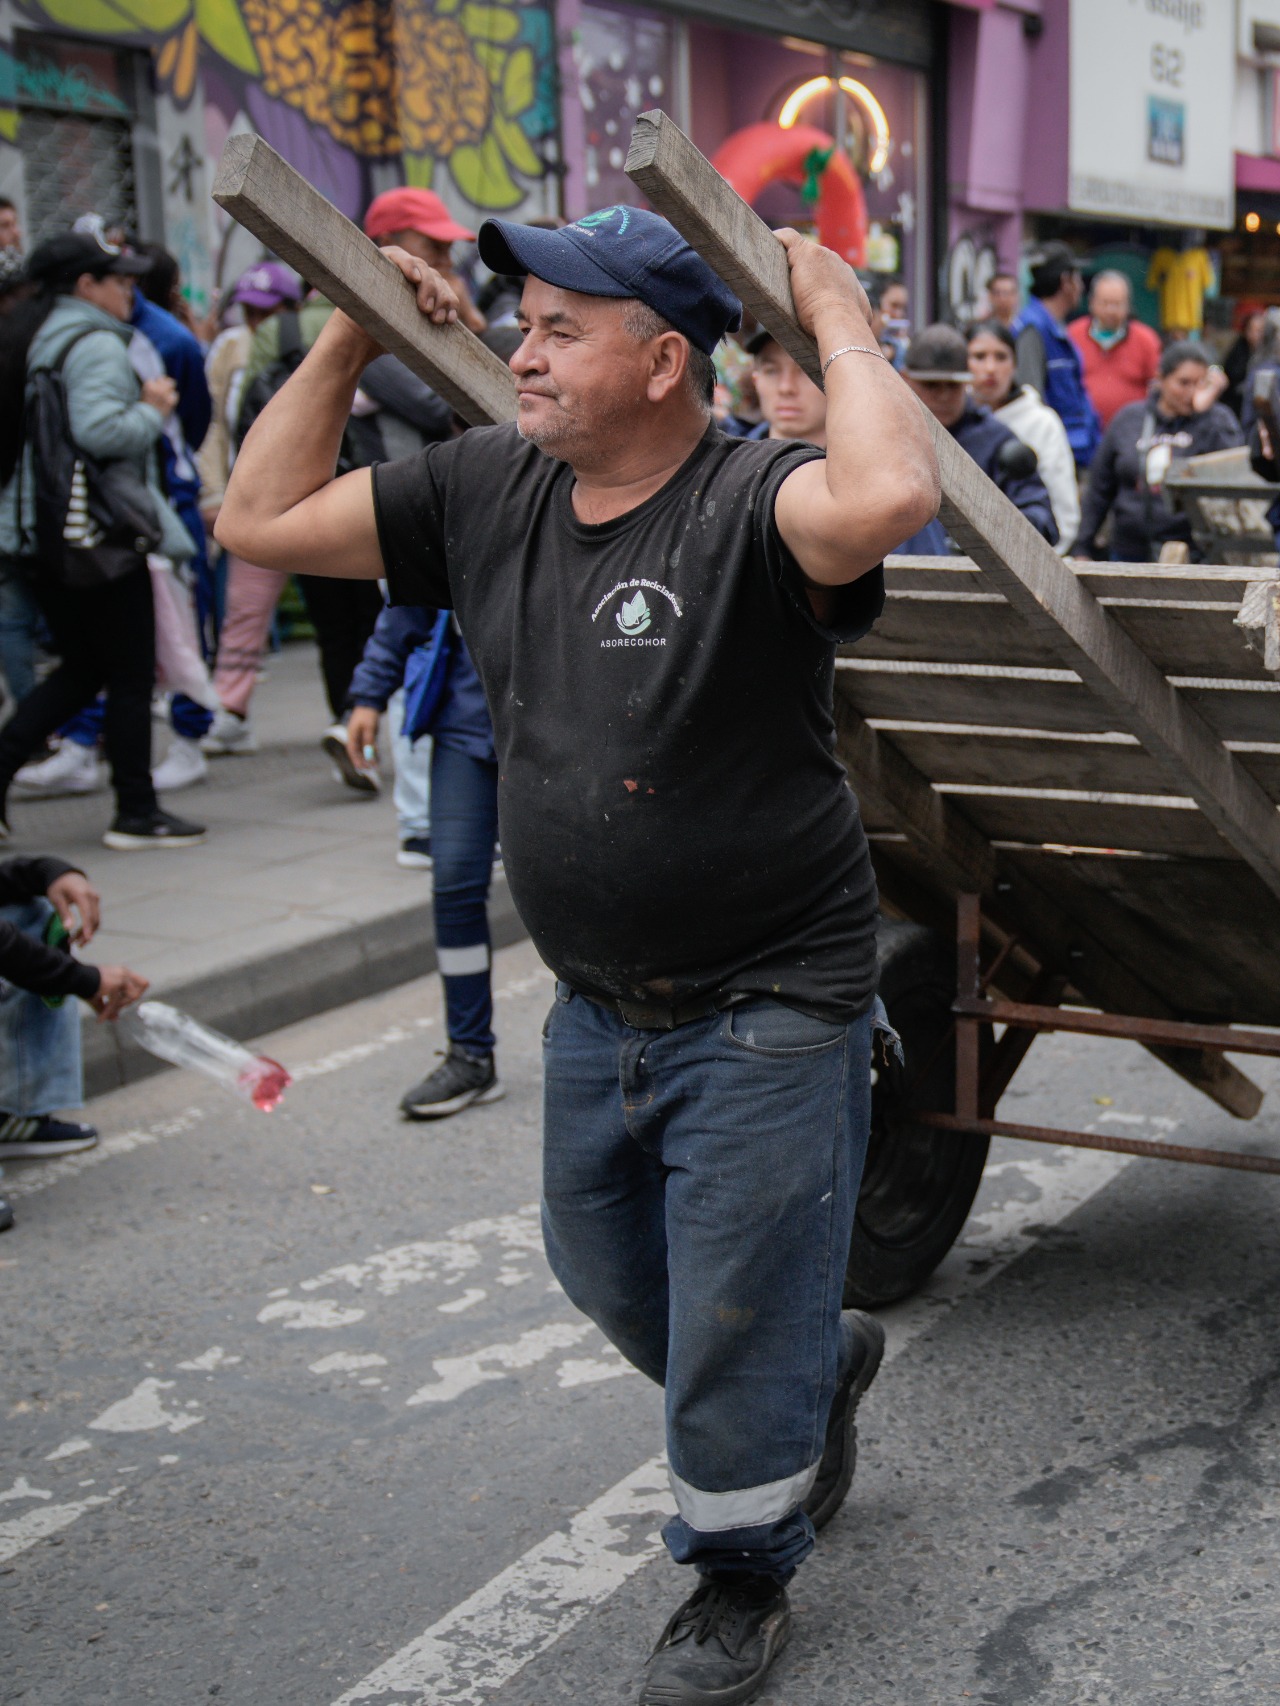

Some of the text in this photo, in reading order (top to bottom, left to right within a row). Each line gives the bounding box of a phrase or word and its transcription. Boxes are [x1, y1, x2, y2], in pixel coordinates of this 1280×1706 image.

[1127, 0, 1206, 35] asaje
[1151, 42, 1185, 88] 62
[591, 578, 683, 622] Asociación de Recicladores
[600, 638, 667, 648] ASORECOHOR
